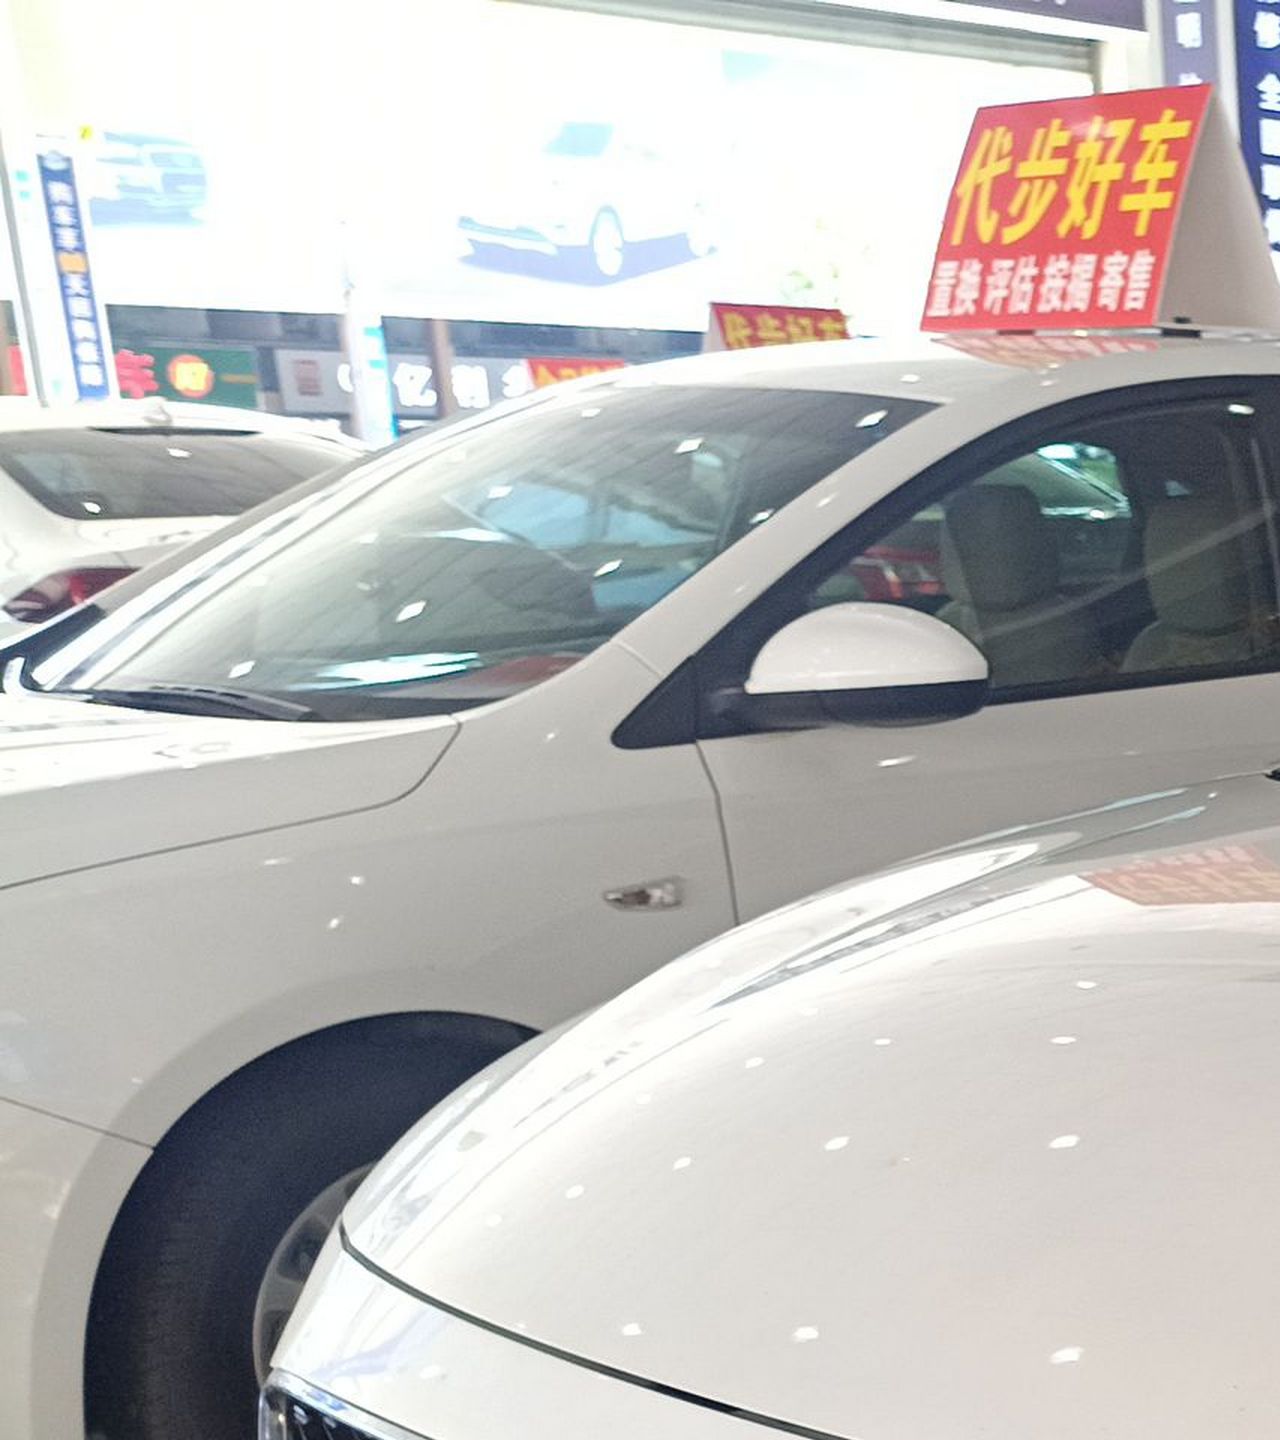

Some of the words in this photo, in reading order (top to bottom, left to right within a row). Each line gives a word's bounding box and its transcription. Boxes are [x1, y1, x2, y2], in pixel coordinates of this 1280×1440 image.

[950, 108, 1193, 246] 代步好车
[926, 257, 983, 317] 置换
[983, 254, 1039, 315] 评估
[1098, 248, 1156, 312] 寄售
